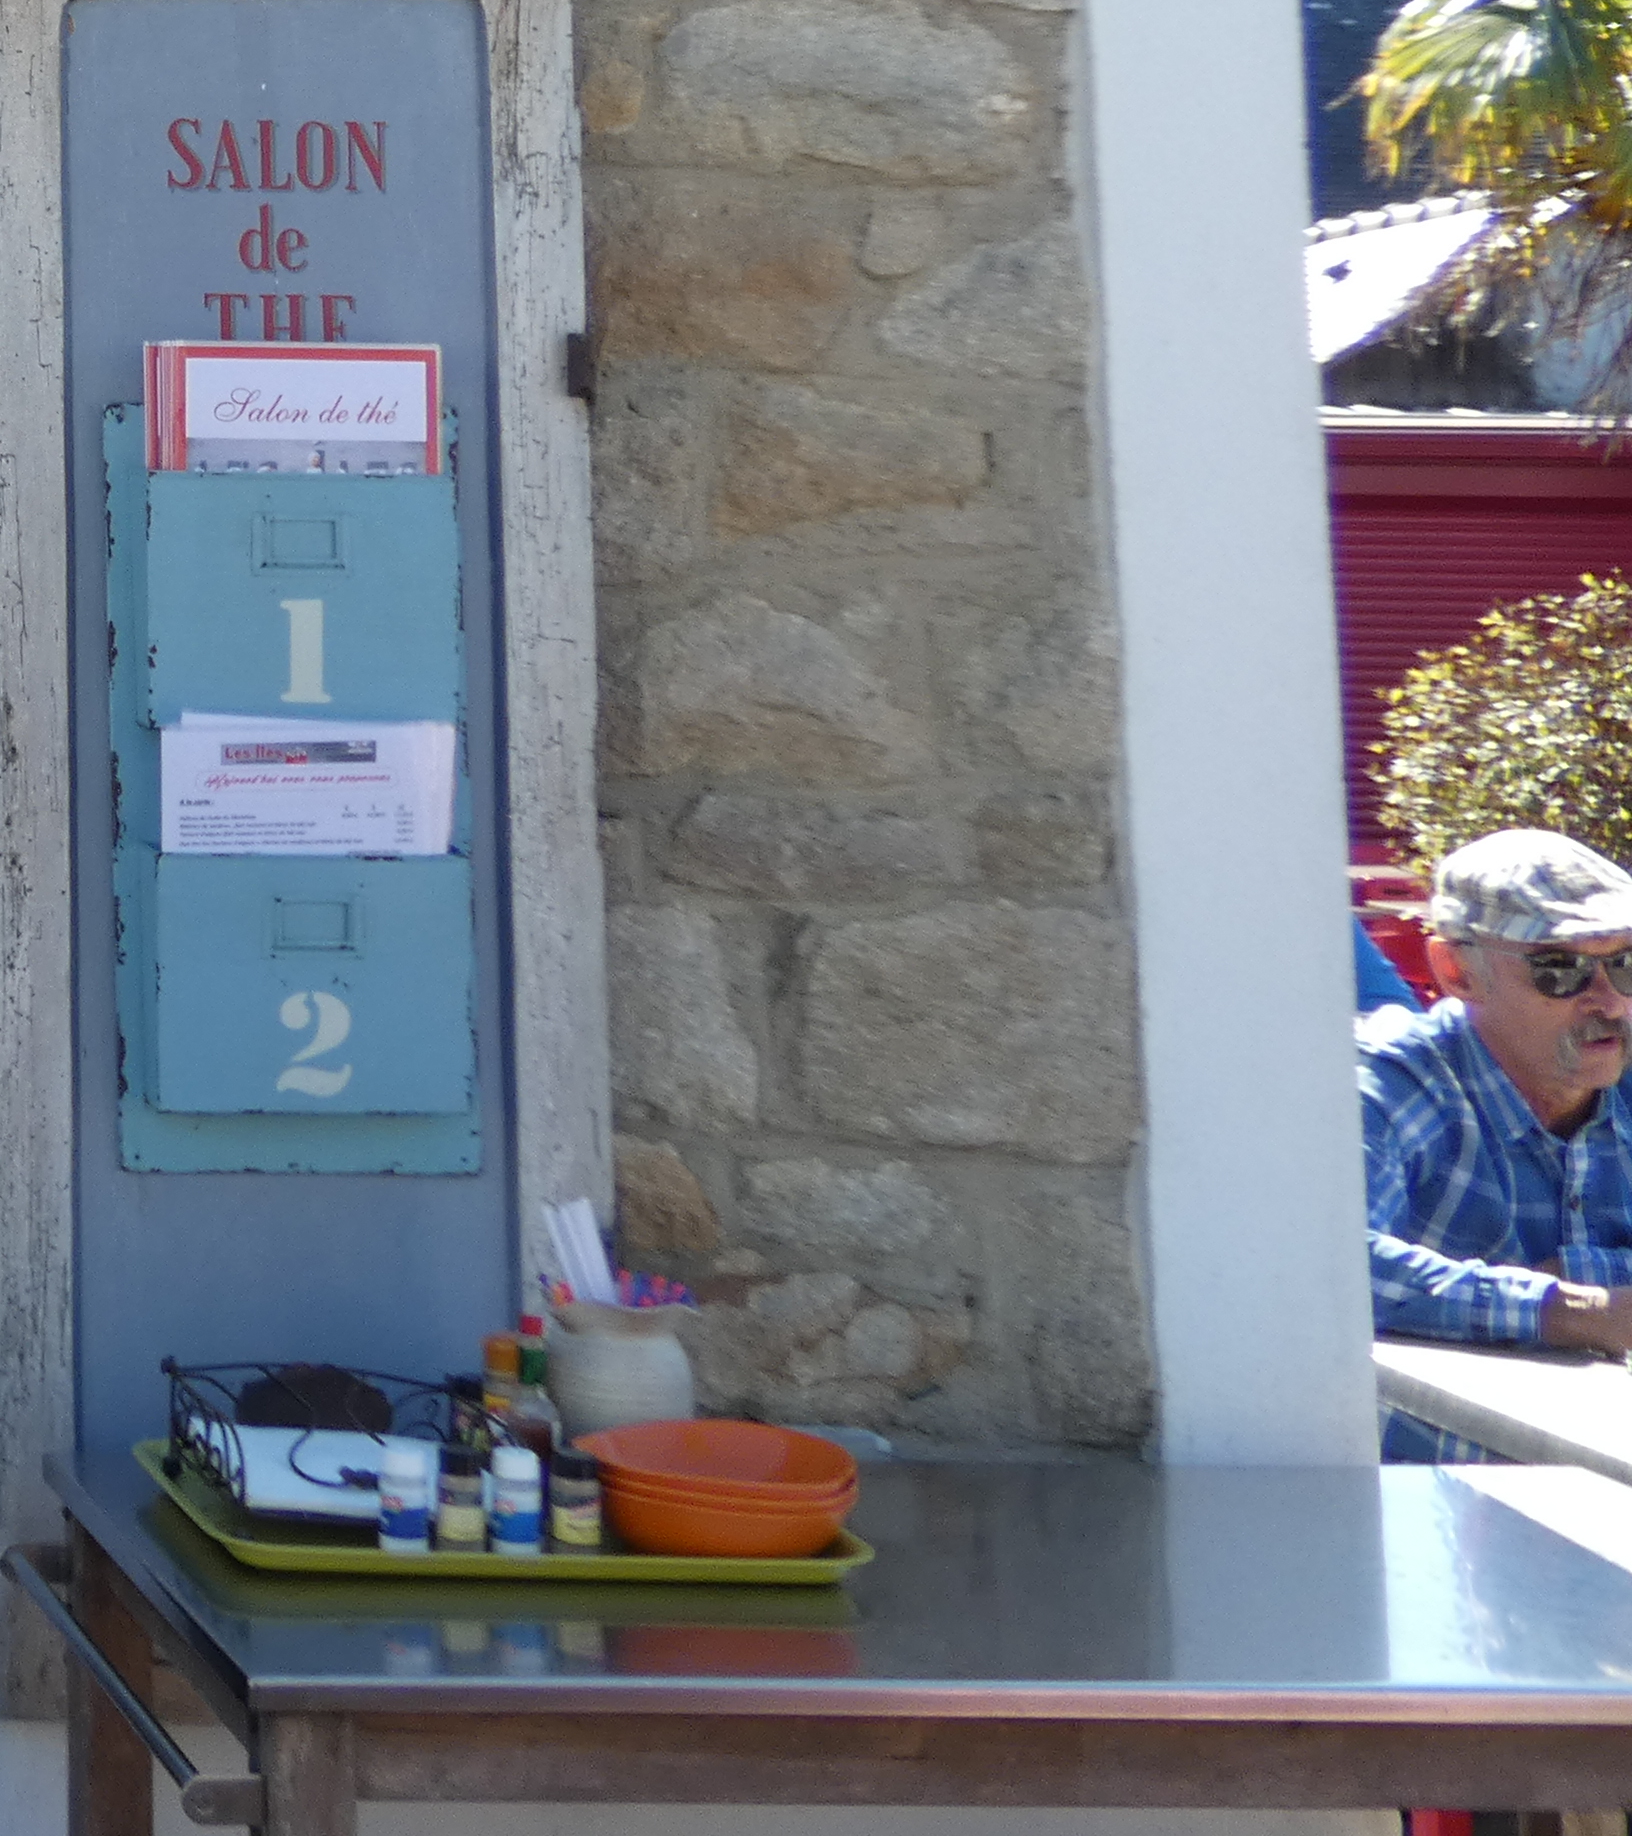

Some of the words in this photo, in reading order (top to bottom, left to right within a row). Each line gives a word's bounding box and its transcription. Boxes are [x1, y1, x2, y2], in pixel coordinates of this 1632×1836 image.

[166, 117, 388, 193] SALON
[238, 202, 310, 272] de
[213, 388, 310, 423] Salon
[318, 395, 349, 424] de
[356, 396, 400, 425] thé
[279, 598, 332, 705] 1
[276, 990, 353, 1100] 2
